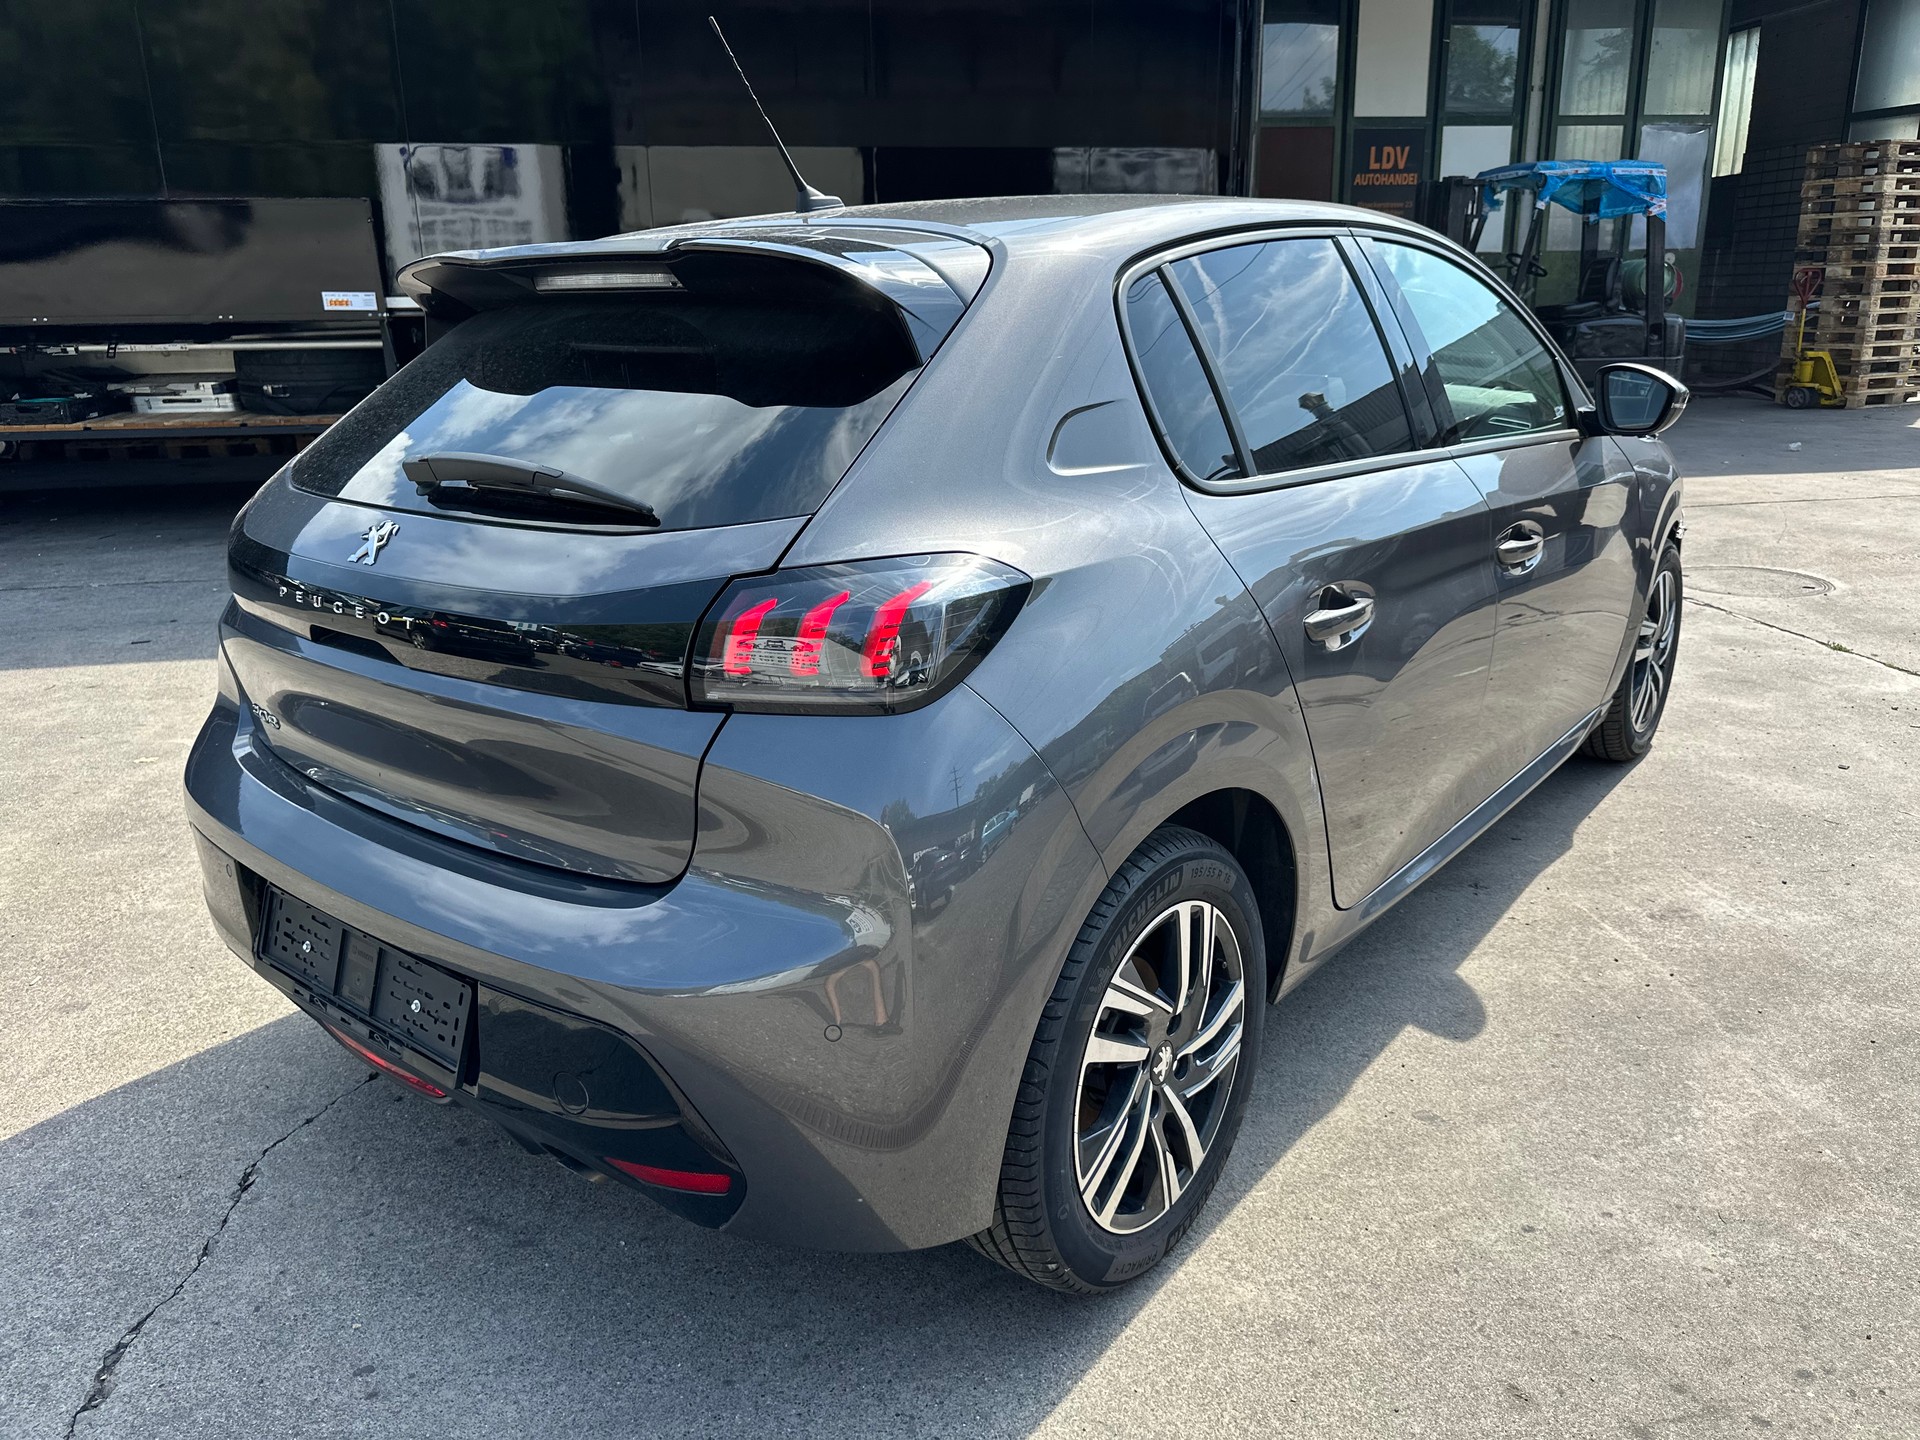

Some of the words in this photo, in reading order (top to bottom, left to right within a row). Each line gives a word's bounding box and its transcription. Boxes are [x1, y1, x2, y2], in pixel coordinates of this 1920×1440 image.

[1369, 146, 1410, 170] LDV
[279, 586, 415, 630] PEUGEOT
[1109, 872, 1180, 962] MICHELIN
[1190, 865, 1217, 880] 195/55
[1119, 1250, 1158, 1274] PRIMACY
